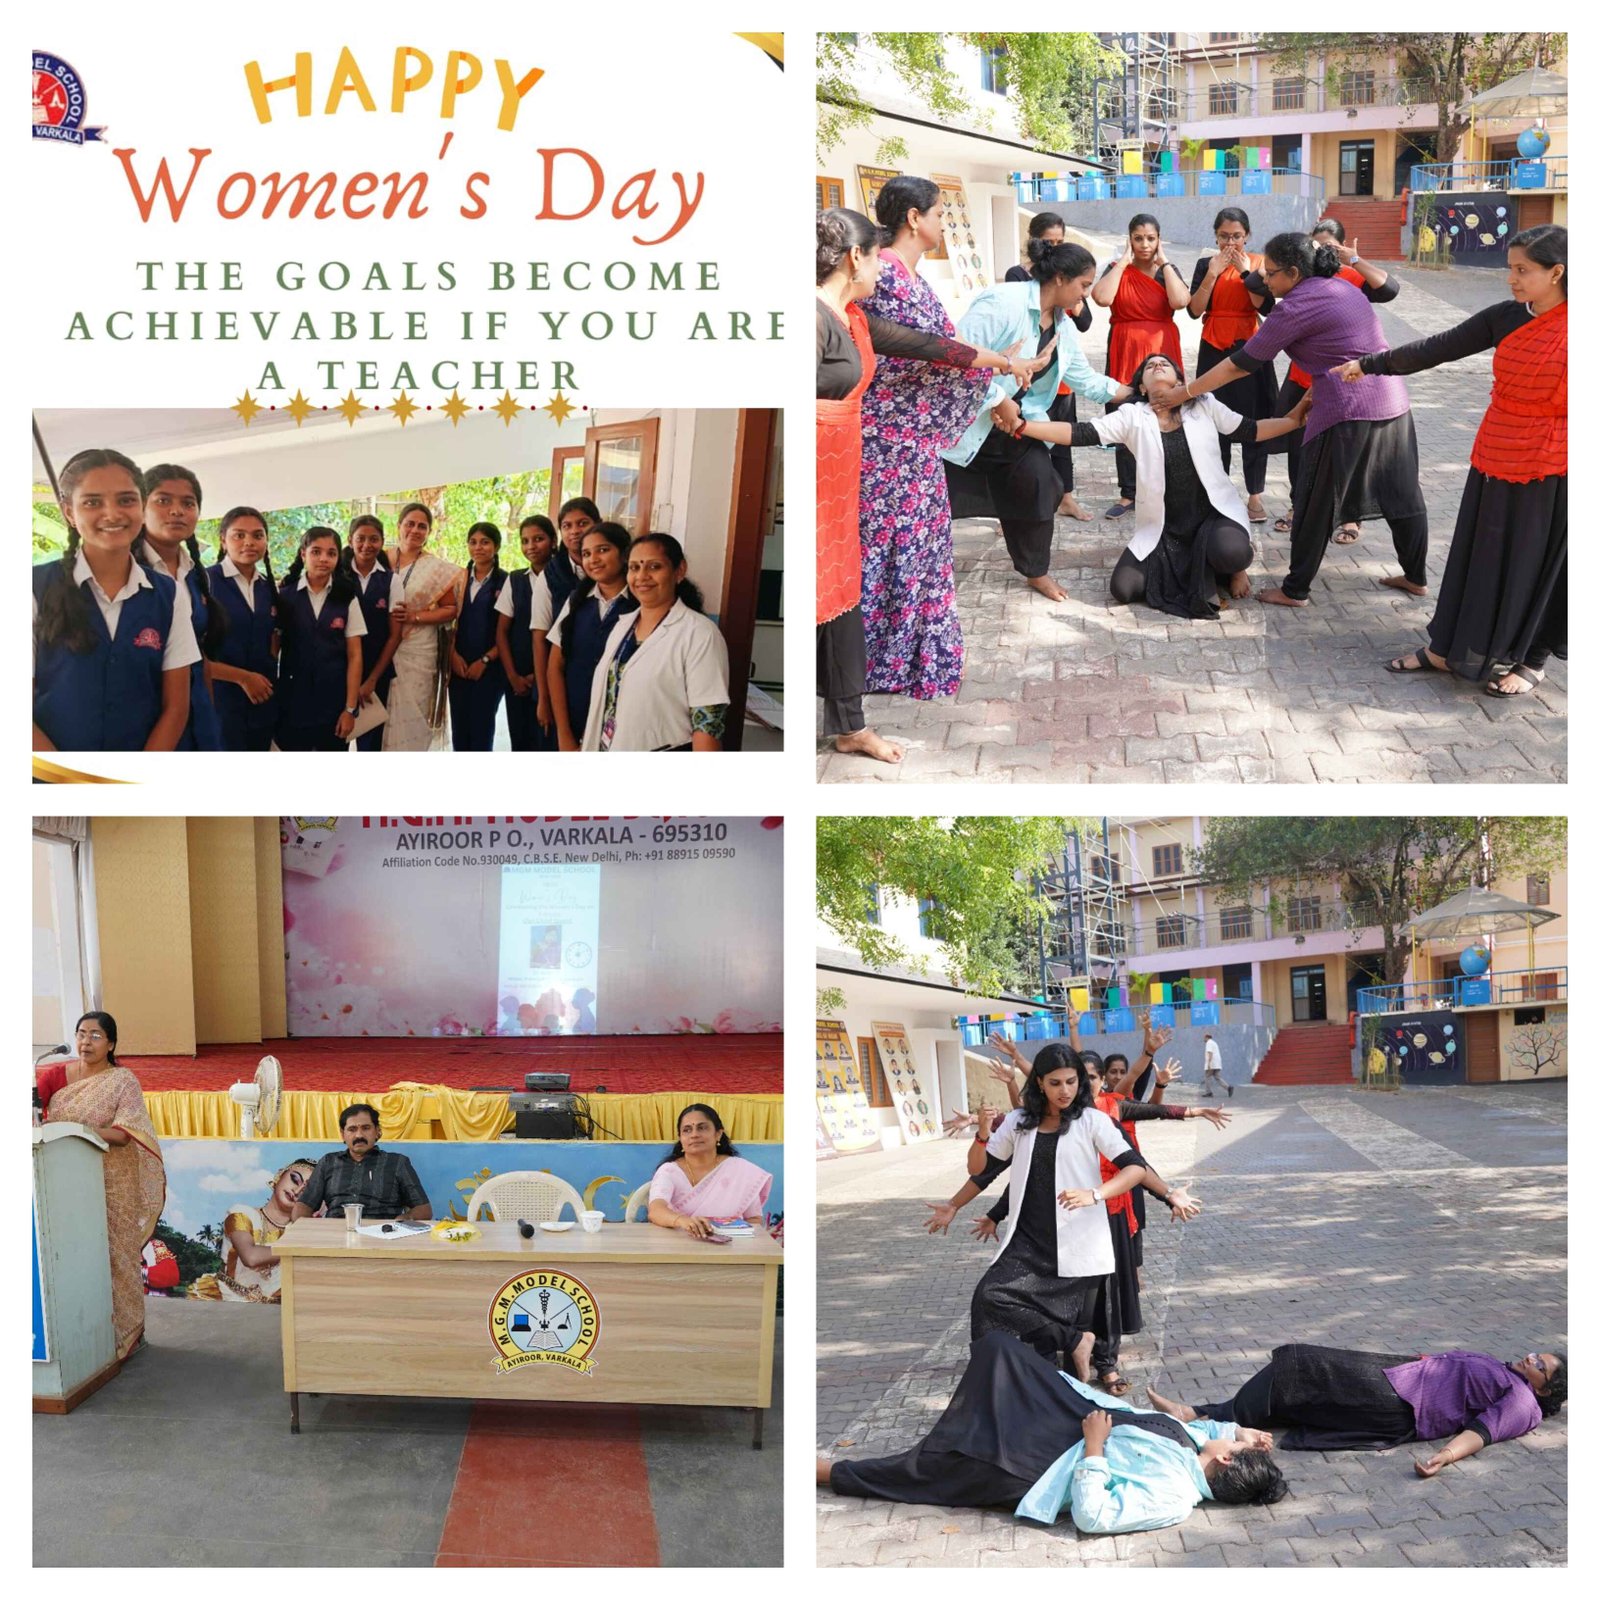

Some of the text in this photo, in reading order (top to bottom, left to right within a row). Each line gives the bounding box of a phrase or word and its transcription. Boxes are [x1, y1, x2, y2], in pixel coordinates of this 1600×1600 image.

[396, 831, 483, 851] AYIROOR
[489, 830, 501, 848] P
[507, 829, 534, 850] O.,
[540, 828, 633, 846] VARKALA
[652, 823, 727, 843] 695310
[383, 847, 736, 868] Affiliation Code No.930049, C.B.S.E. New Delhi, Ph: +91 88915 09590
[569, 1287, 594, 1346] SCHOOL
[507, 1354, 582, 1369] AYIROOR, VARKALA
